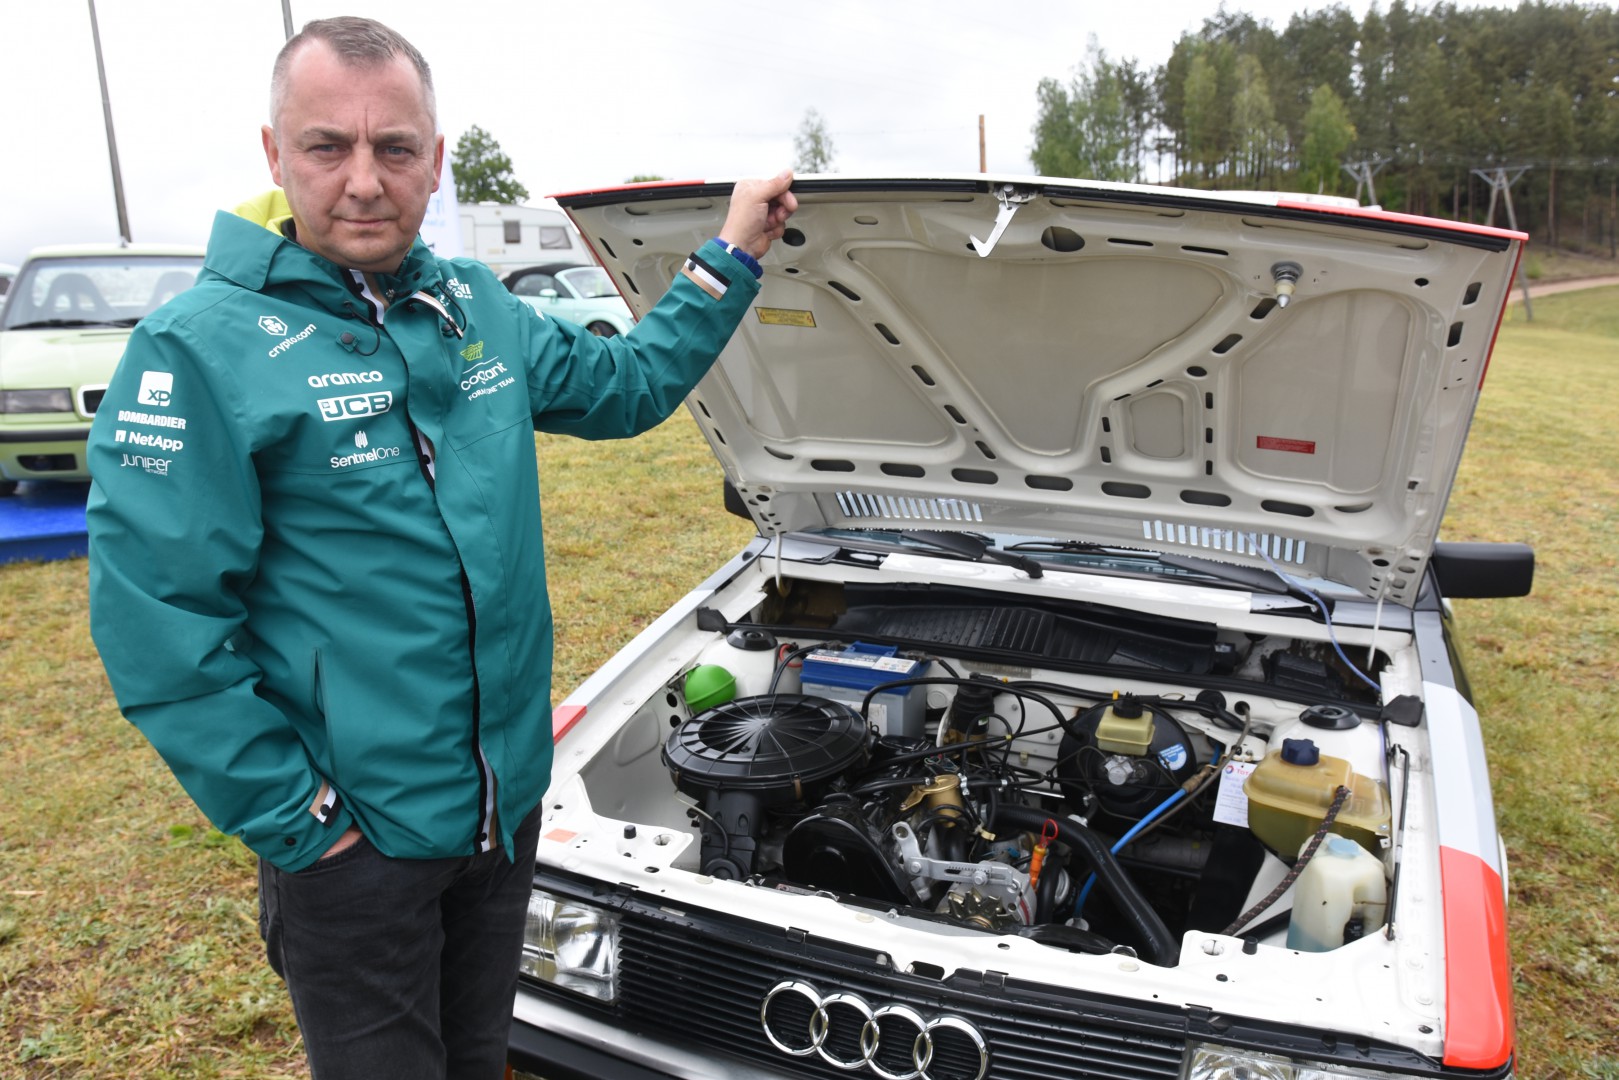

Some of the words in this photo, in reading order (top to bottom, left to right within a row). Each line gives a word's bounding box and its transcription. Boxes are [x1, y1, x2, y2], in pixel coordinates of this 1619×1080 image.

[268, 323, 317, 358] crypto.com
[307, 370, 383, 388] aramco
[498, 376, 516, 388] TEAM
[324, 395, 390, 419] JCB
[117, 410, 187, 430] BOMBARDIER
[128, 431, 184, 452] NetApp
[330, 446, 400, 468] SentinelOne
